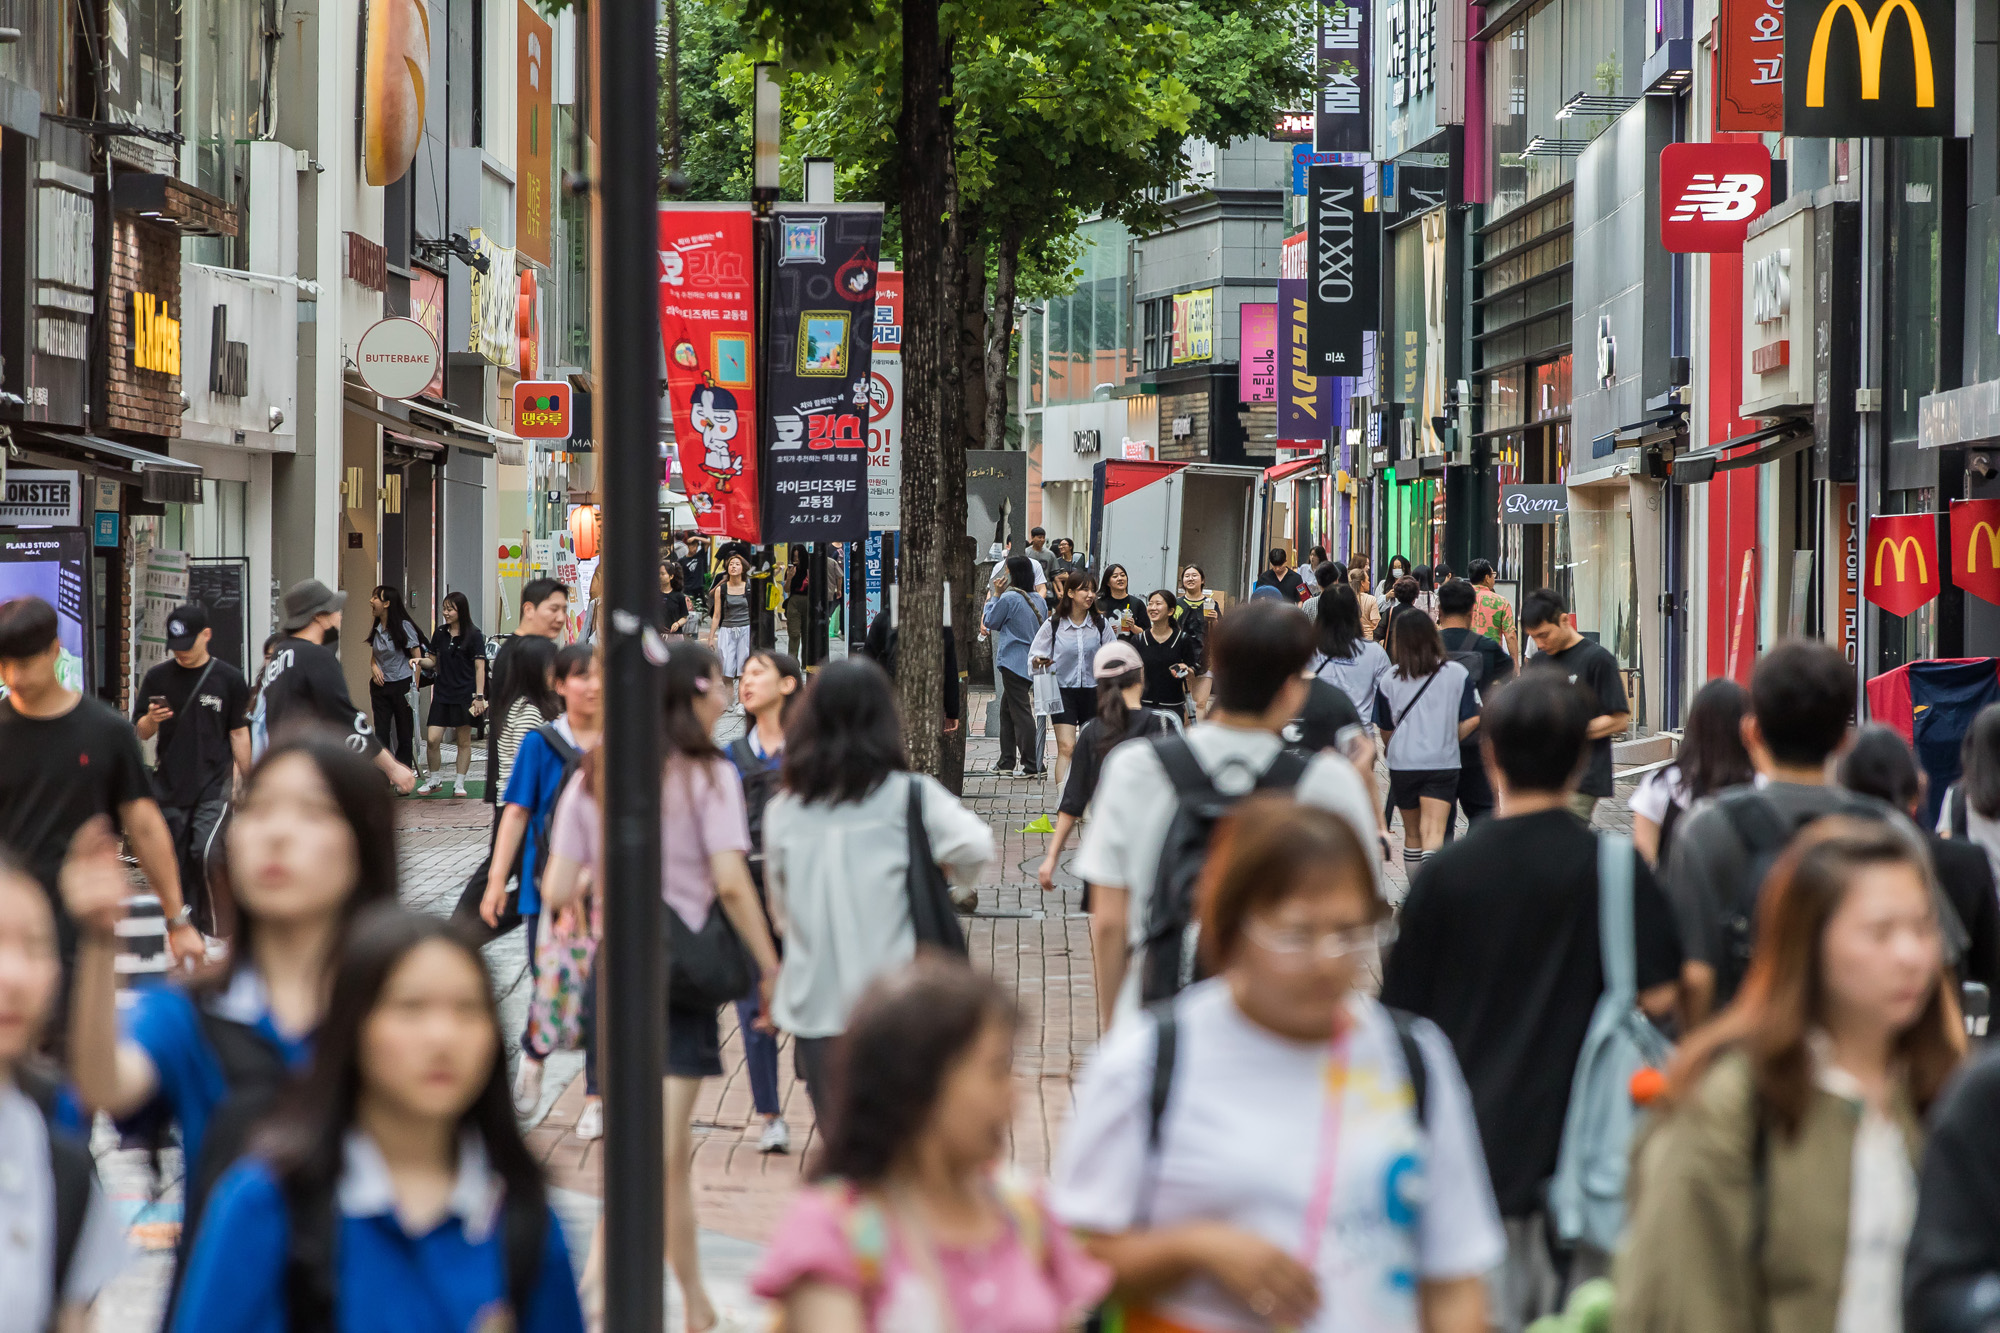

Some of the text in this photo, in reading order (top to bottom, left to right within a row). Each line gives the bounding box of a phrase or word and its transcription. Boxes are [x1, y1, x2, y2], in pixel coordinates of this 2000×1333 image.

[1319, 186, 1353, 303] MIXXO
[722, 309, 748, 321] 교동점
[872, 325, 902, 344] 거리
[365, 354, 430, 364] BUTTERBAKE
[1326, 352, 1345, 363] 미쏘
[867, 428, 891, 453] O!
[776, 480, 857, 494] 라이크디즈위드
[867, 478, 888, 487] 만원의
[8, 484, 71, 502] ONSTER
[868, 487, 895, 496] 과됩니다
[798, 495, 833, 509] 교동점
[1505, 493, 1568, 515] Roem
[6, 541, 60, 550] PLAN.B STUDIO
